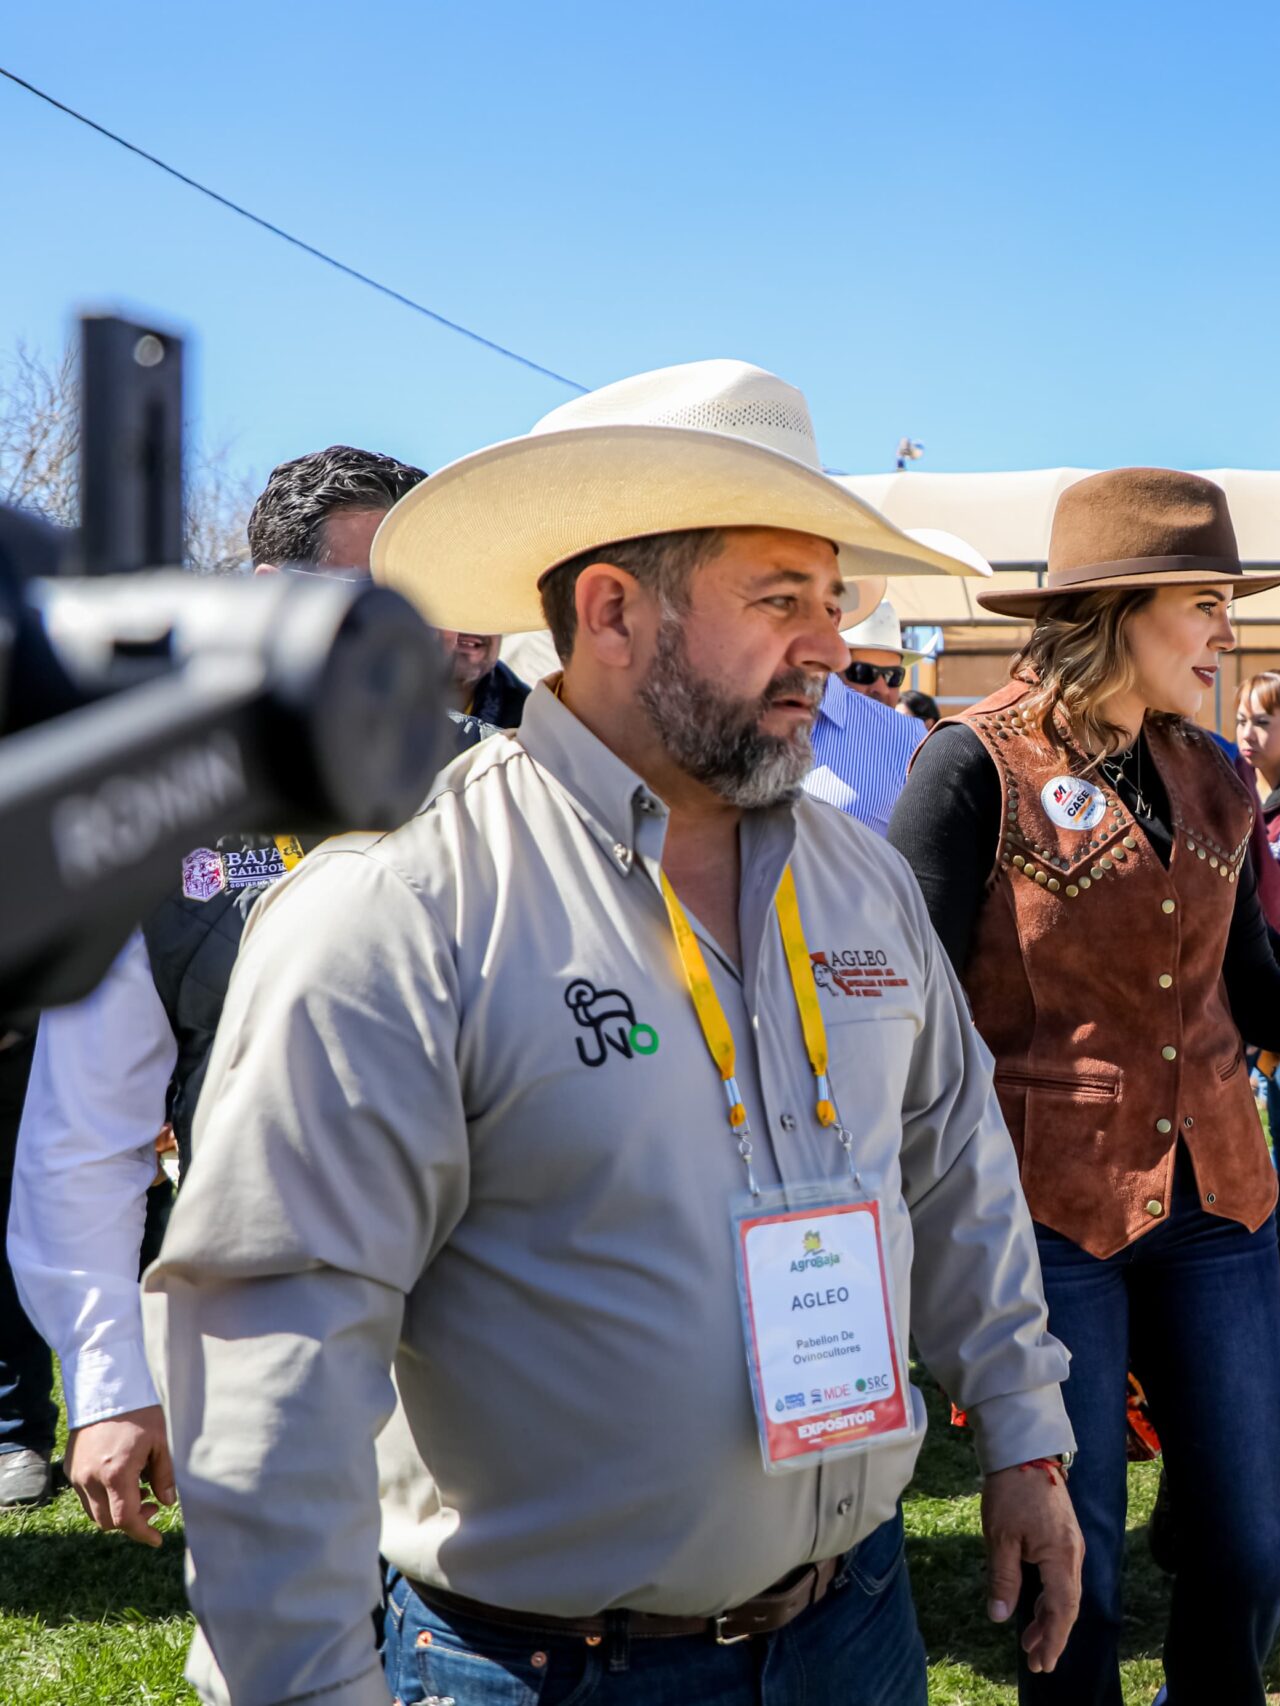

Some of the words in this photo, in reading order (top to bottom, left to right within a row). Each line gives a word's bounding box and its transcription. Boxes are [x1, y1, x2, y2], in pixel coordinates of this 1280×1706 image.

[1067, 790, 1090, 817] CASE
[226, 848, 281, 867] BAJA
[832, 950, 888, 967] AGLEO
[575, 1020, 660, 1067] UNO
[790, 1253, 841, 1273] AgroBaja
[791, 1286, 849, 1311] AGLEO
[796, 1334, 839, 1349] Pabellon
[841, 1330, 855, 1341] De
[793, 1344, 862, 1365] Ovinocultores
[824, 1384, 851, 1400] MDE
[867, 1374, 889, 1390] SRC
[798, 1409, 876, 1439] EXPOSITOR
